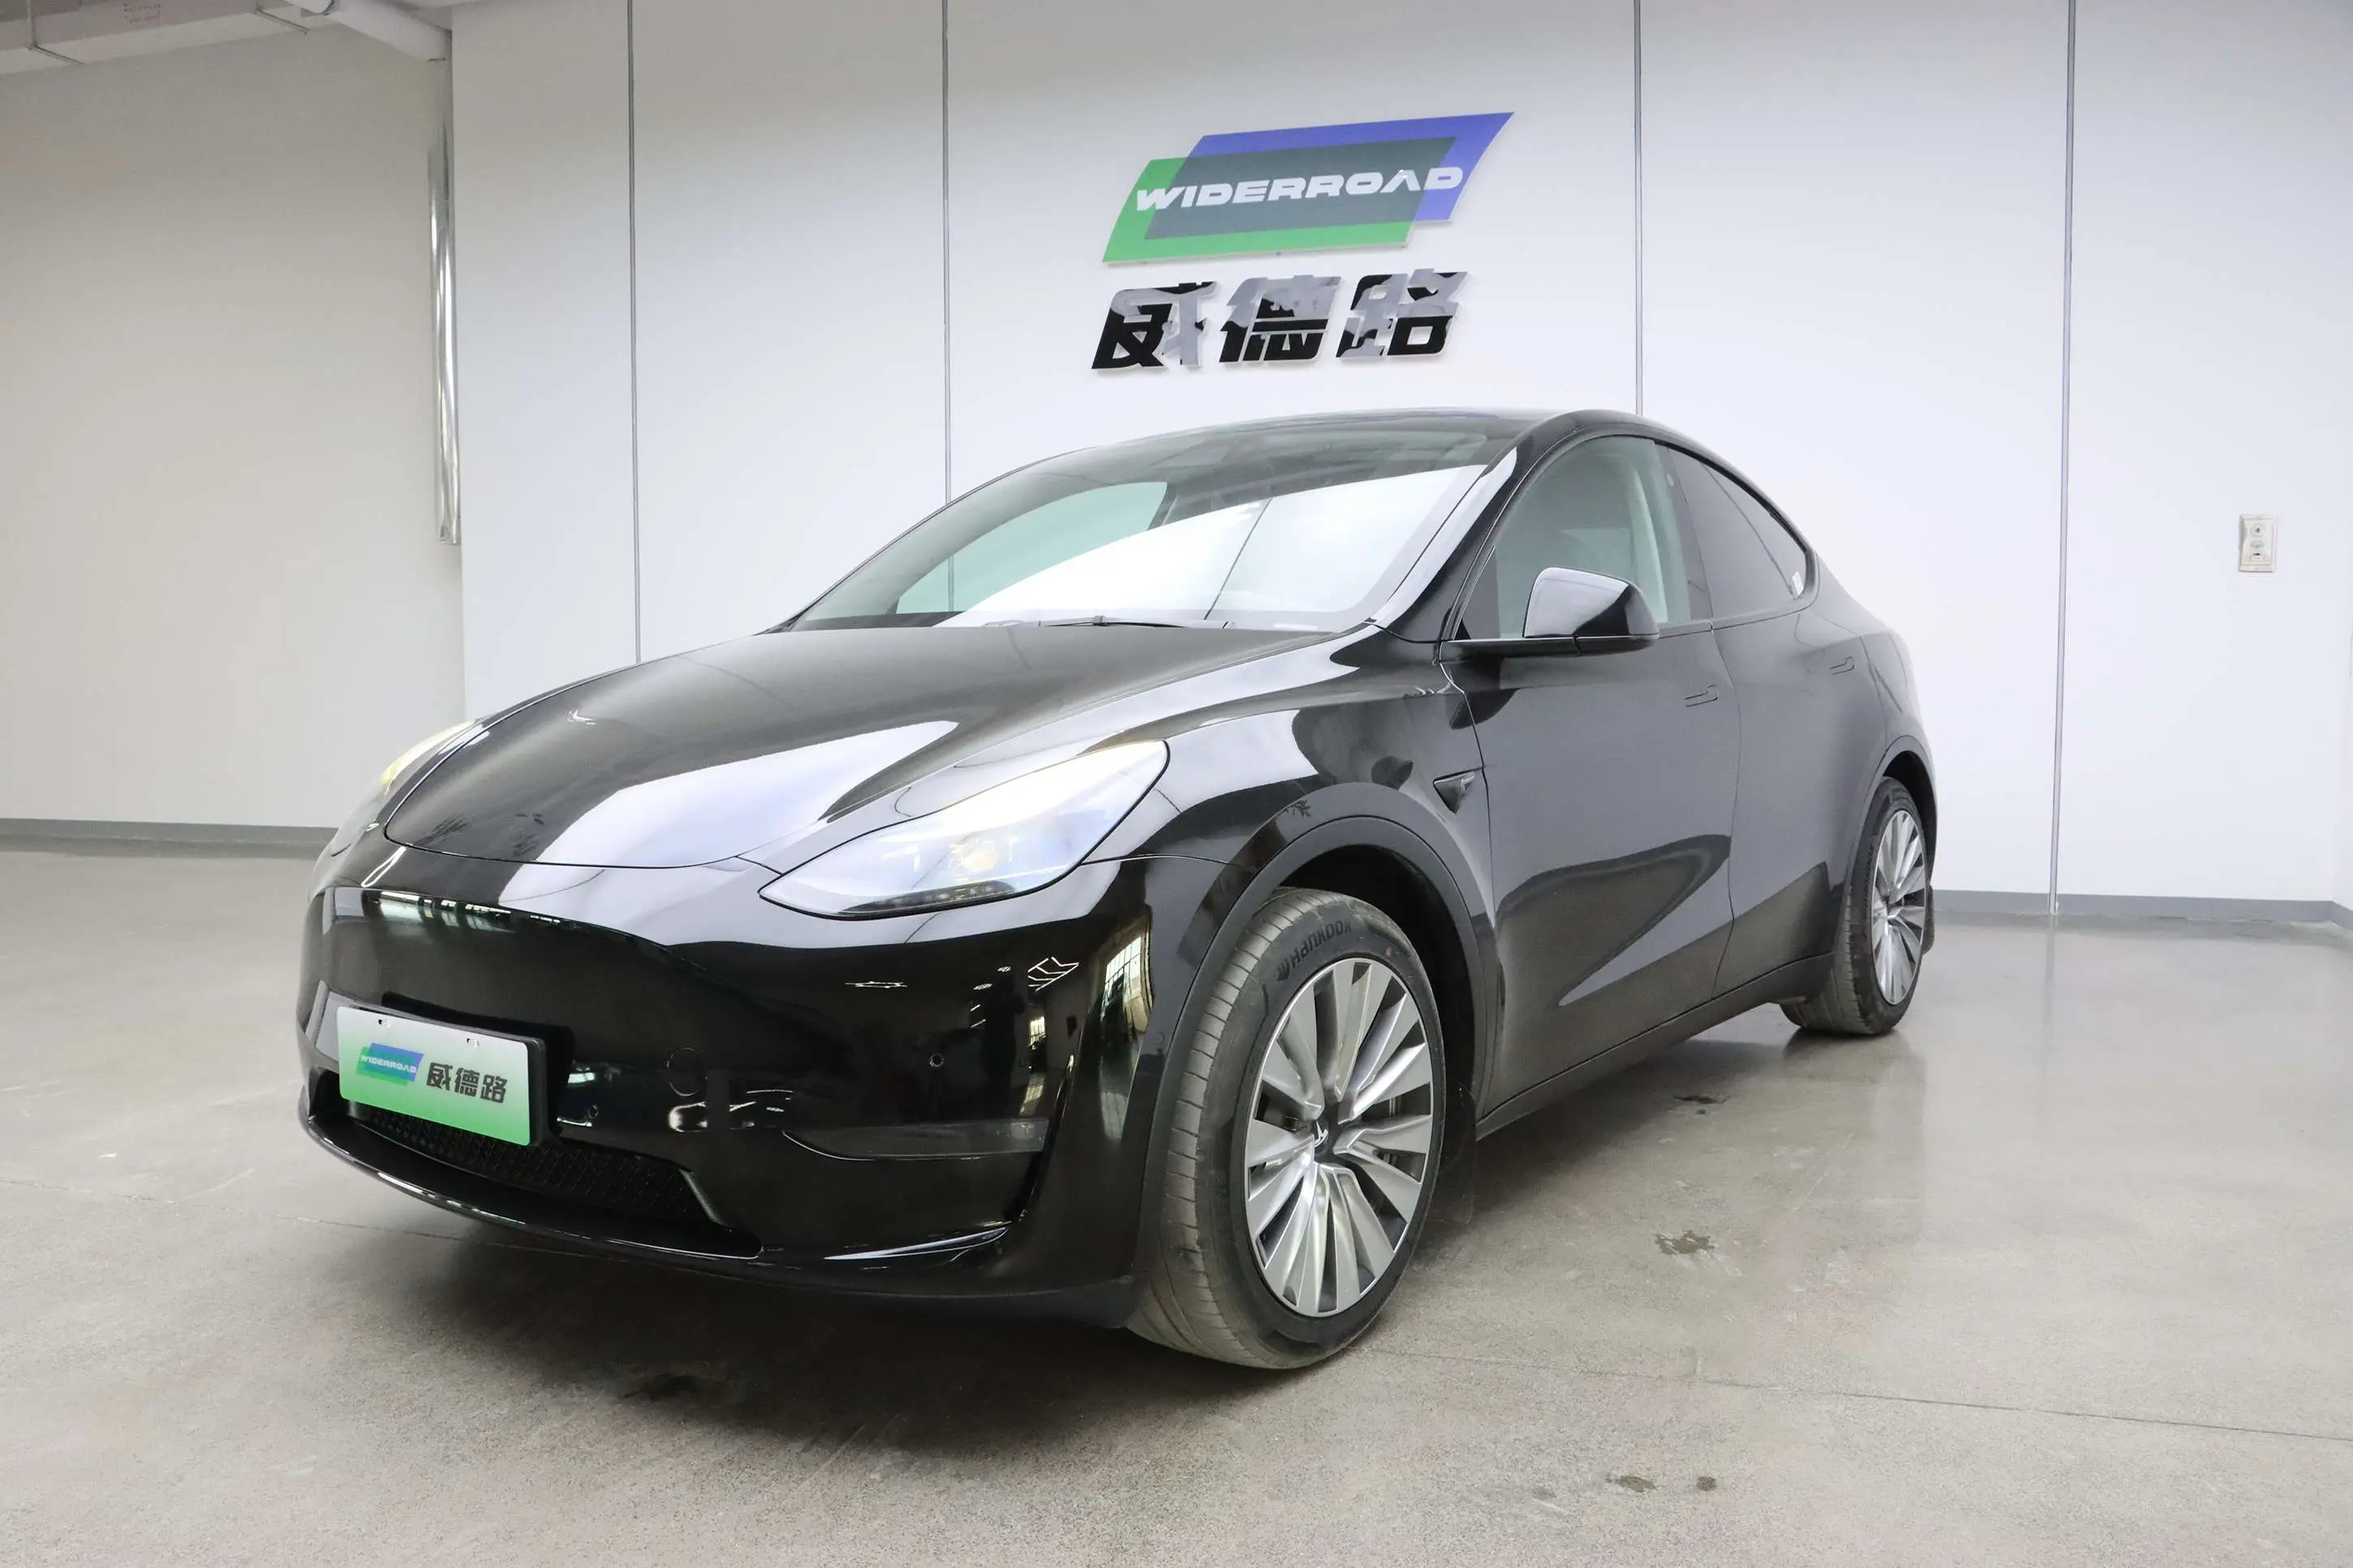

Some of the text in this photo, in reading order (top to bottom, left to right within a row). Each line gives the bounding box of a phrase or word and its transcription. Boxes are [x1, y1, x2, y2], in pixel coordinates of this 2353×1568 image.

[1137, 167, 1464, 212] WIDERROAD
[1091, 268, 1468, 369] 威德路
[361, 1055, 417, 1073] WIDERROAD
[426, 1062, 507, 1104] 威德路
